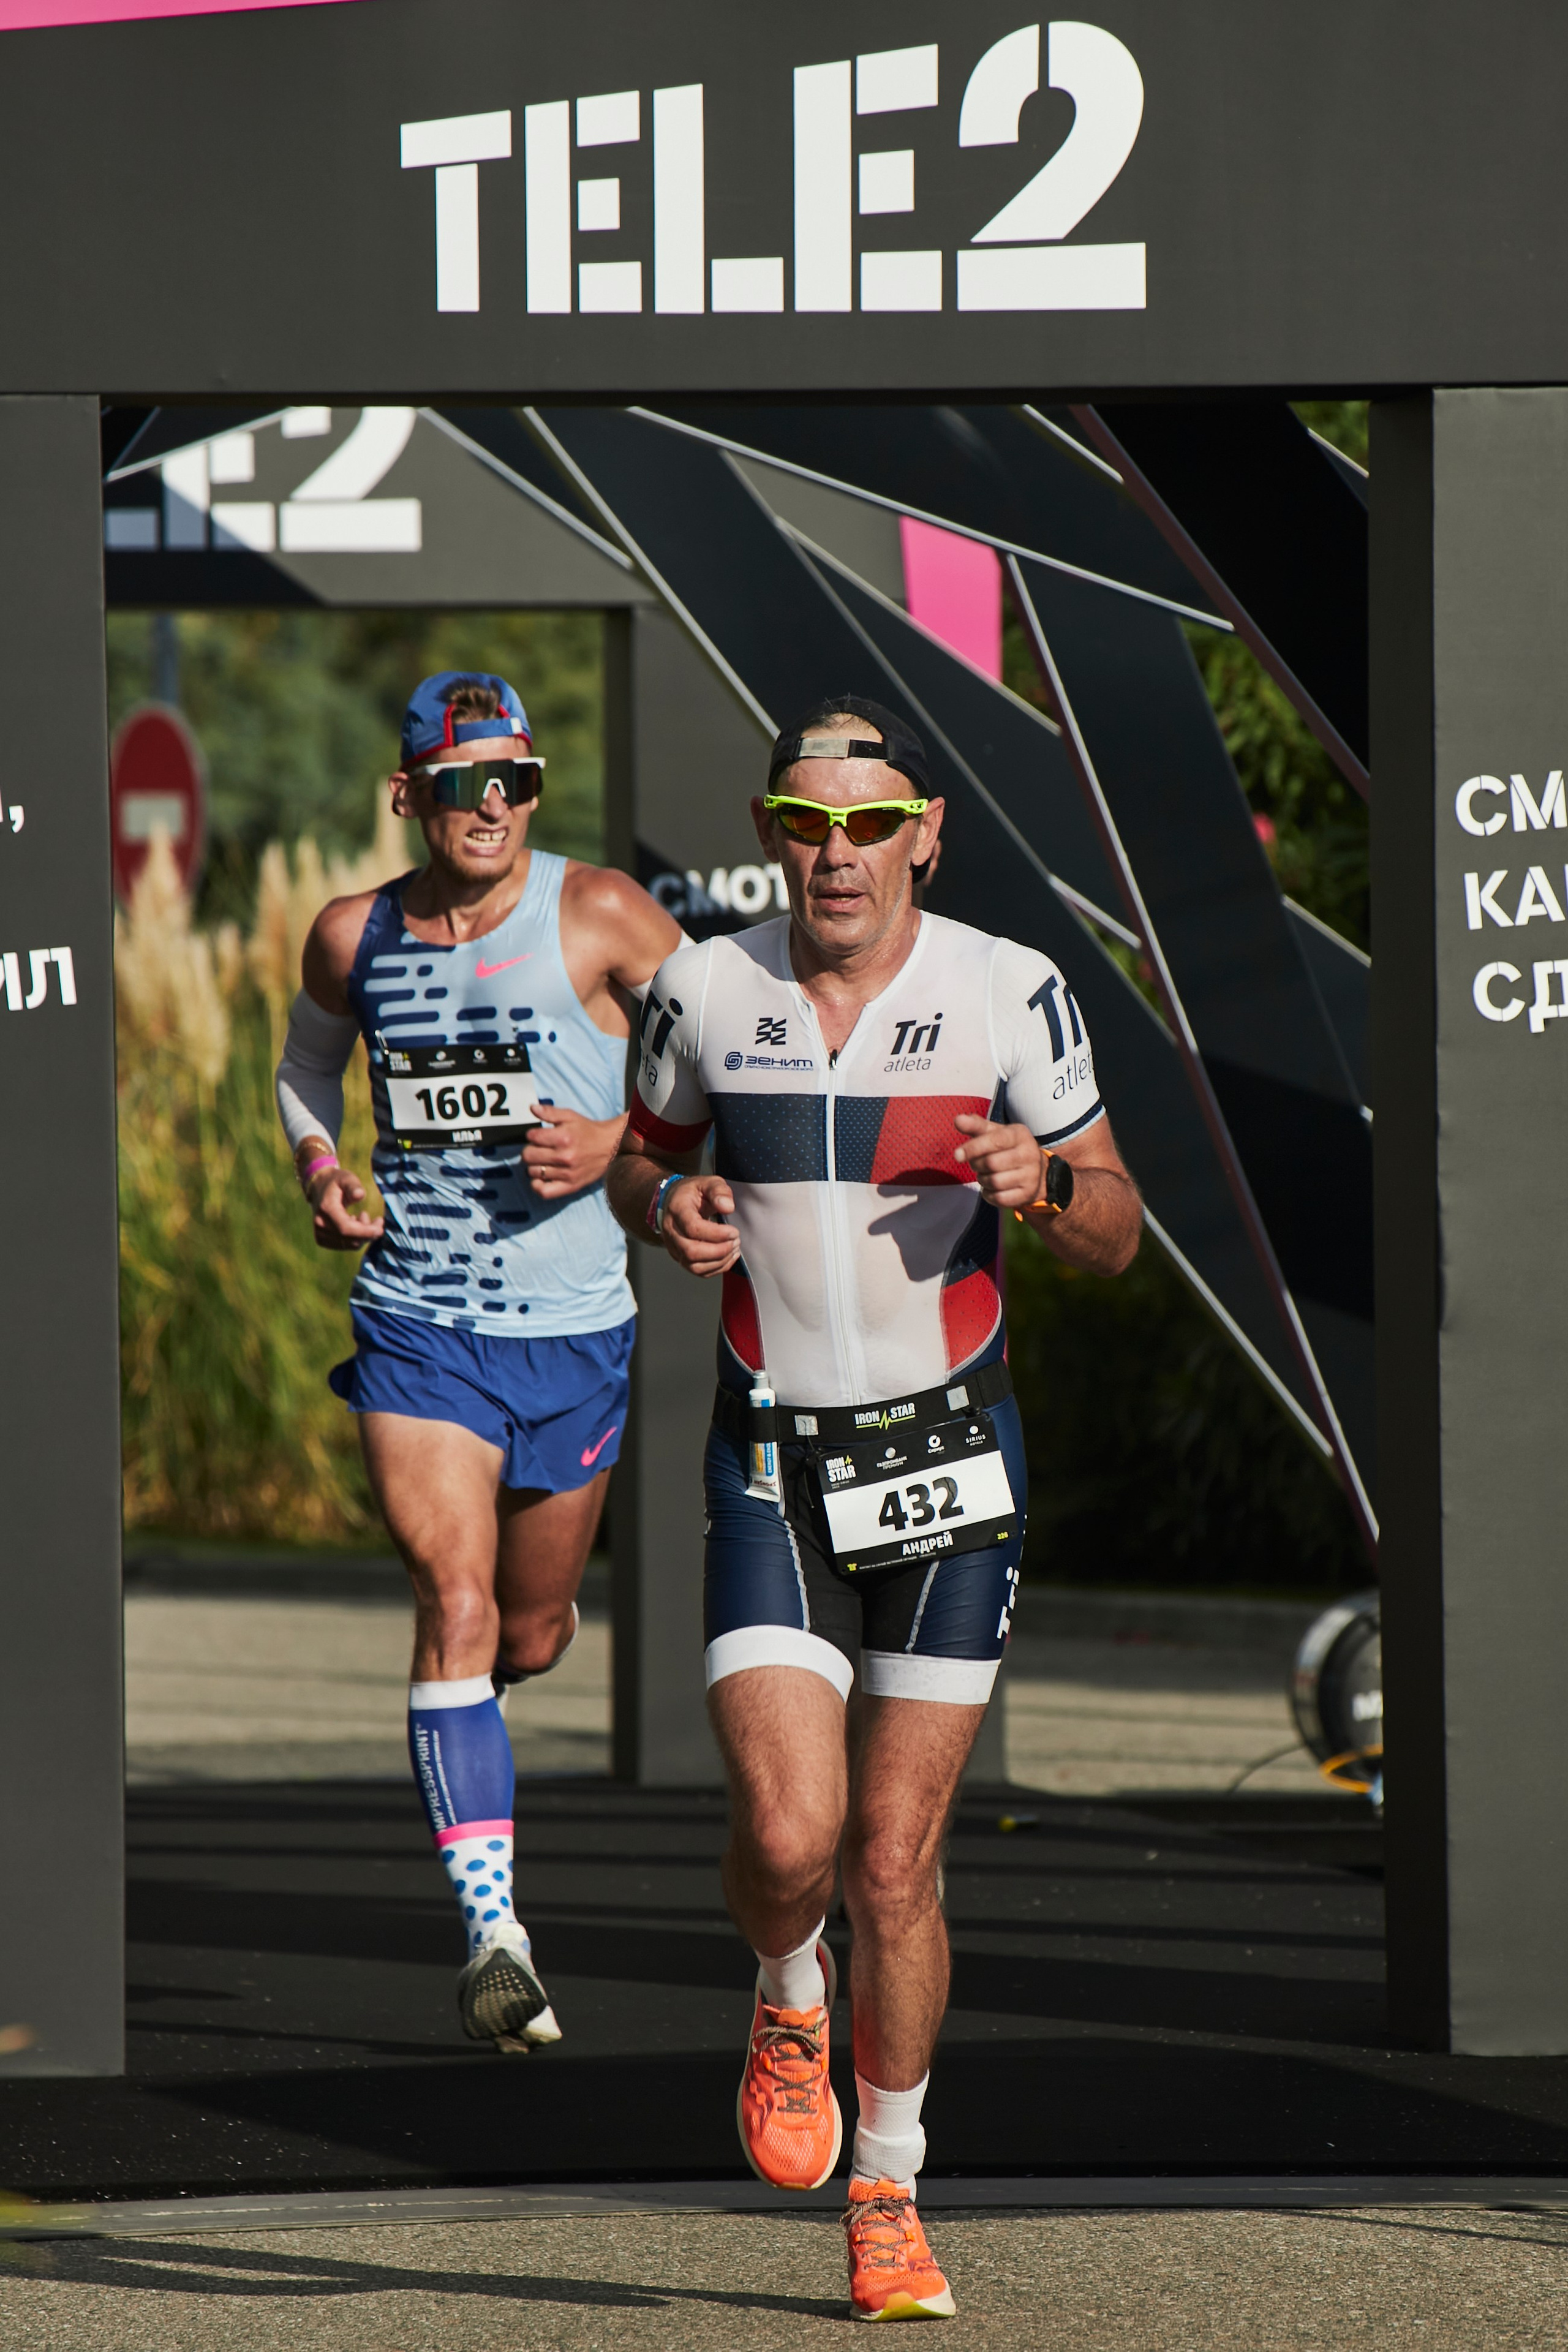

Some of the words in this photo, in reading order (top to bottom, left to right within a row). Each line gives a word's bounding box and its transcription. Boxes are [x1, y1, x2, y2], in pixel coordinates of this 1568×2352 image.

[401, 20, 1147, 314] TELE2
[106, 407, 421, 551] E2
[1464, 864, 1568, 930] КА
[890, 1012, 943, 1055] Tri
[884, 1057, 932, 1072] atleta
[415, 1083, 510, 1121] 1602
[452, 1129, 483, 1144] ИЛЬЯ
[854, 1410, 880, 1425] IRON
[890, 1402, 916, 1419] STAR
[965, 1434, 986, 1444] SIRIUS
[826, 1456, 846, 1471] IRON
[827, 1464, 857, 1483] STAR
[878, 1476, 965, 1532] 432
[902, 1531, 954, 1556] АНДРЕЙ
[415, 1728, 447, 1833] MPRESSPRINT
